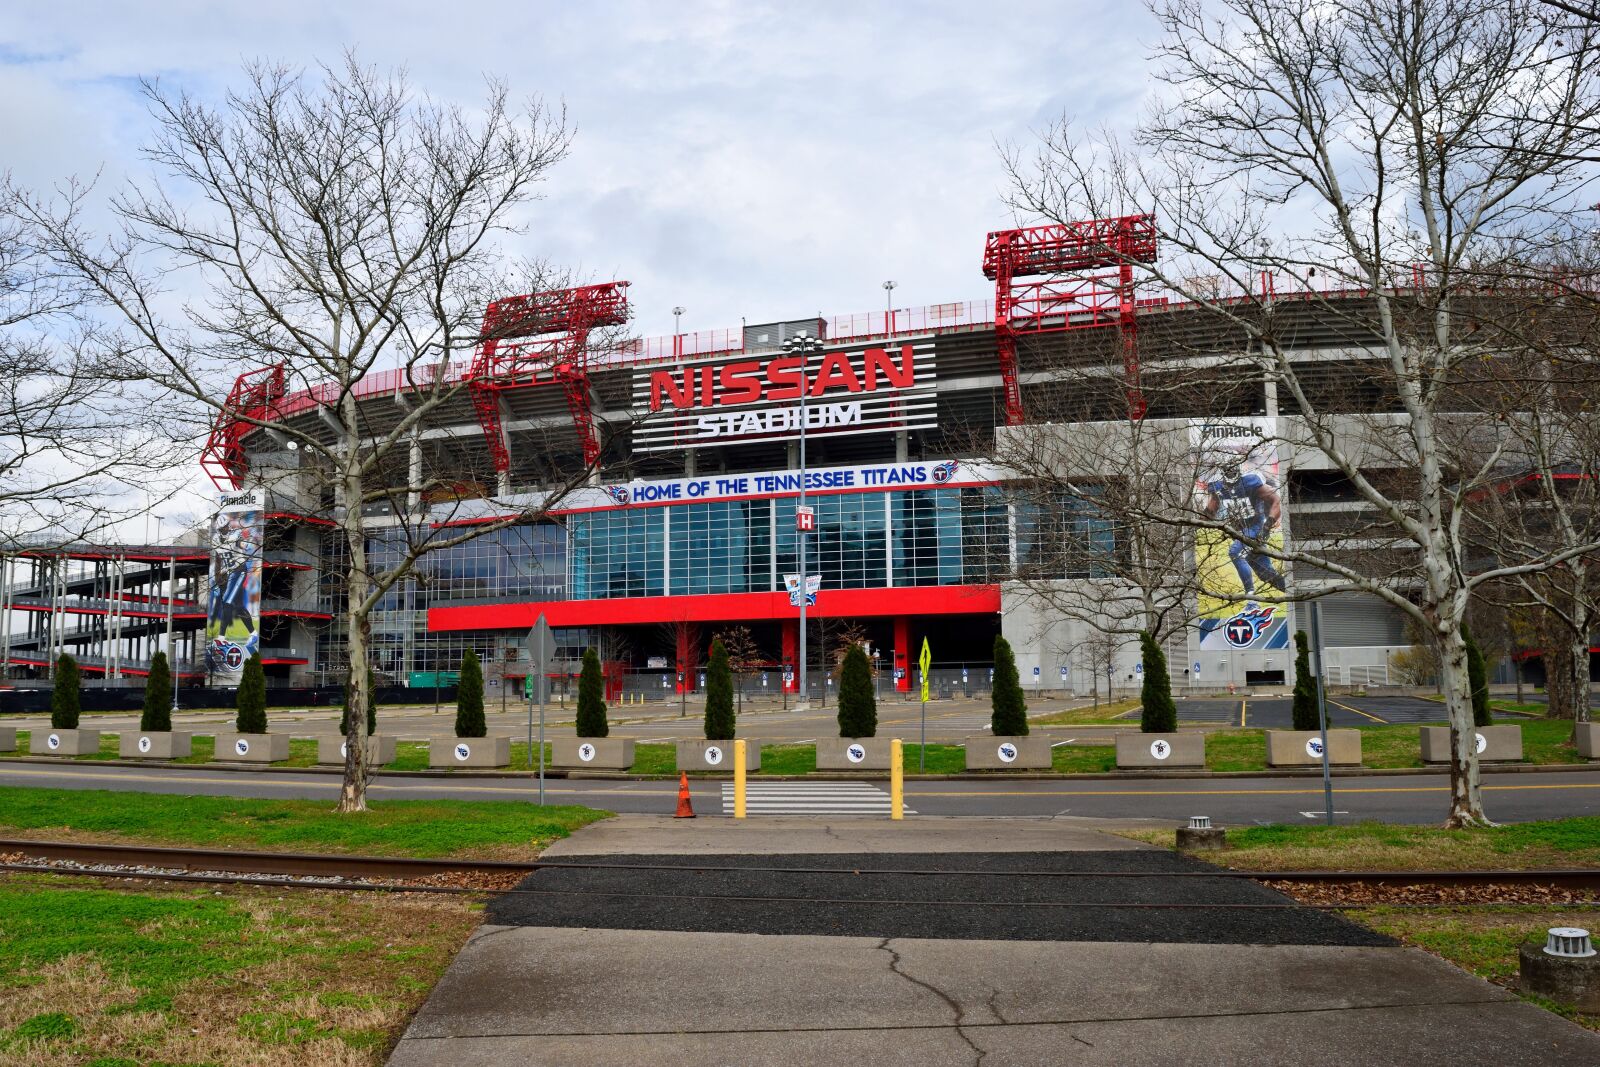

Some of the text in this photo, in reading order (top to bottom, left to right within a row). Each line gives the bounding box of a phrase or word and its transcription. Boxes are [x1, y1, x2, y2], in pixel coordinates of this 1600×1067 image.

[651, 344, 914, 412] NISSAN
[697, 402, 862, 438] STADIUM
[1201, 423, 1263, 440] Pinnacle
[633, 466, 927, 502] HOME OF THE TENNESSEE TITANS
[220, 494, 257, 507] Pinnacle
[801, 514, 812, 529] H
